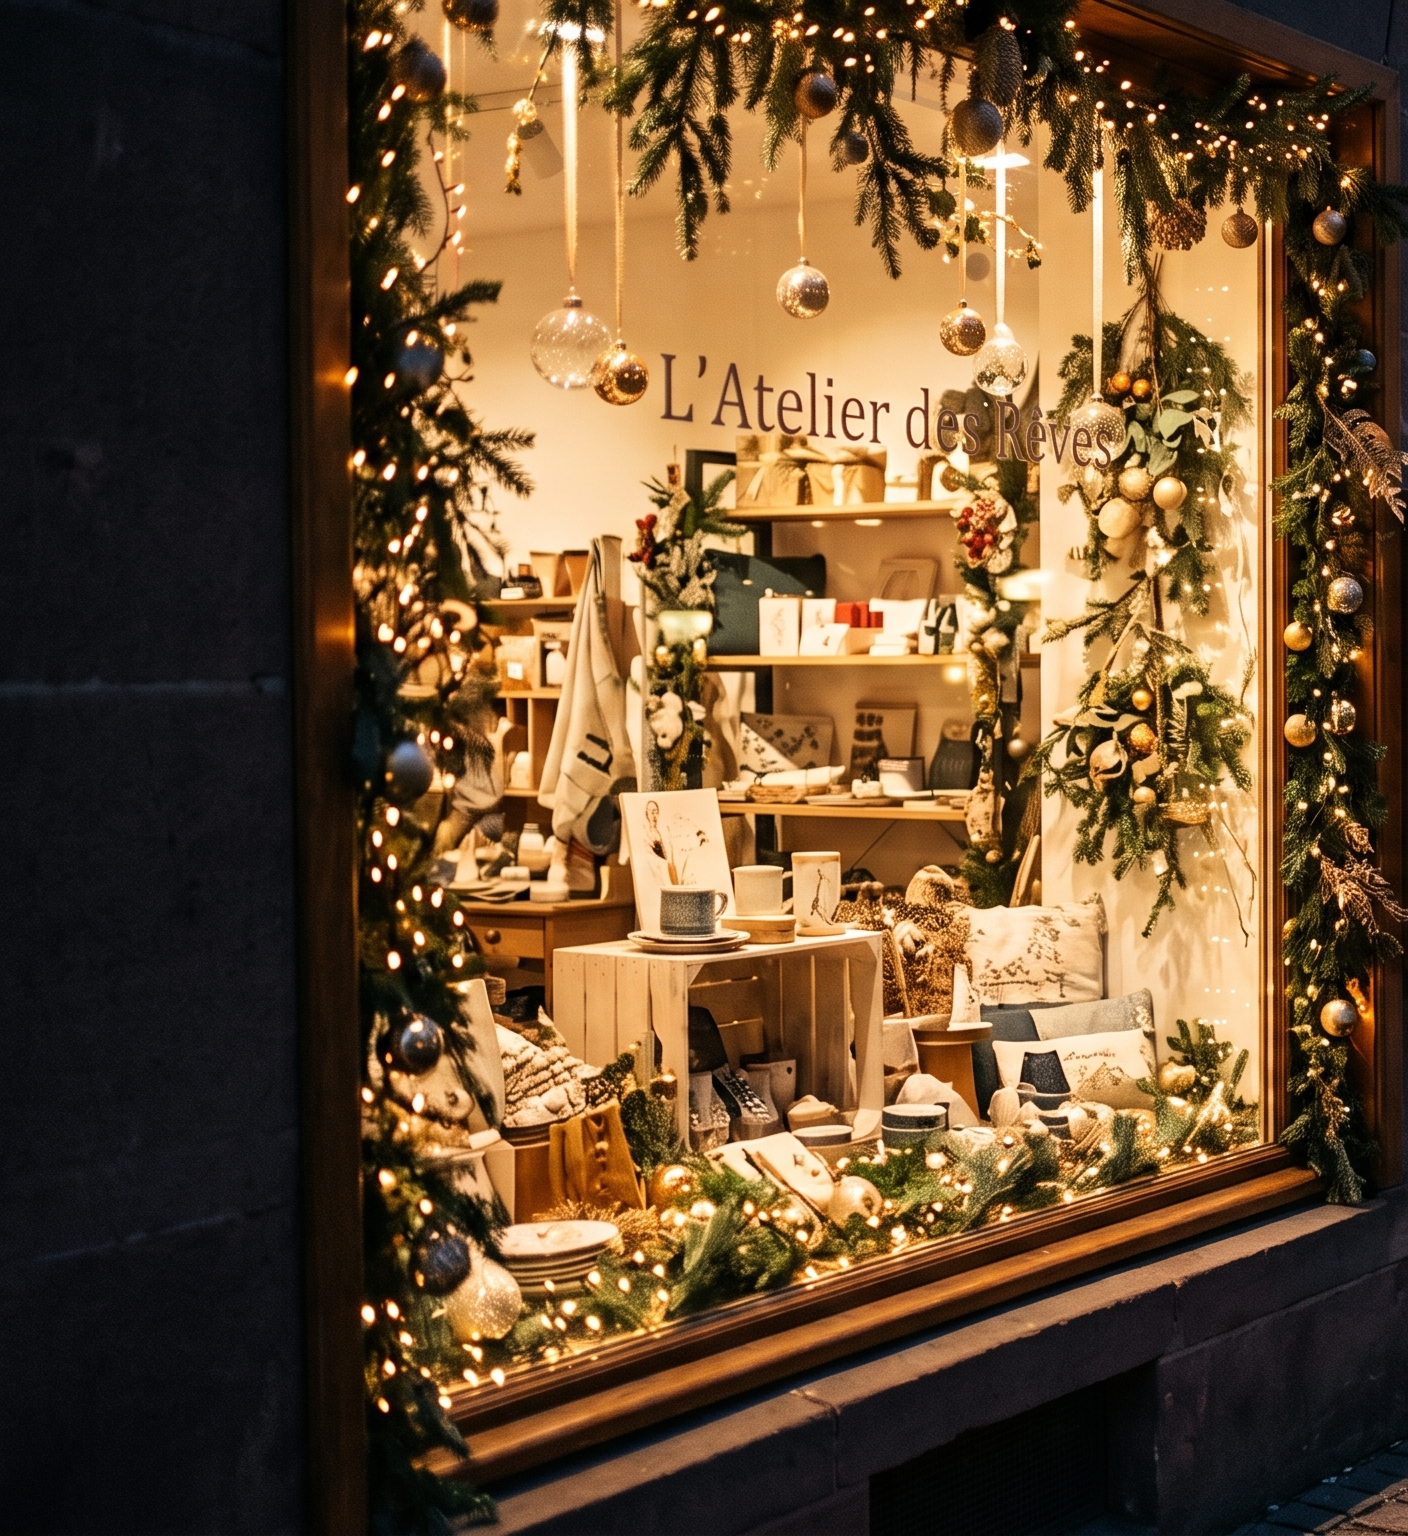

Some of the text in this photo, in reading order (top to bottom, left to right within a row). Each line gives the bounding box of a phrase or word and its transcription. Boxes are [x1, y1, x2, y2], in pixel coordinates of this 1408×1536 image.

[660, 352, 1112, 470] L'Atelier des Rêves
